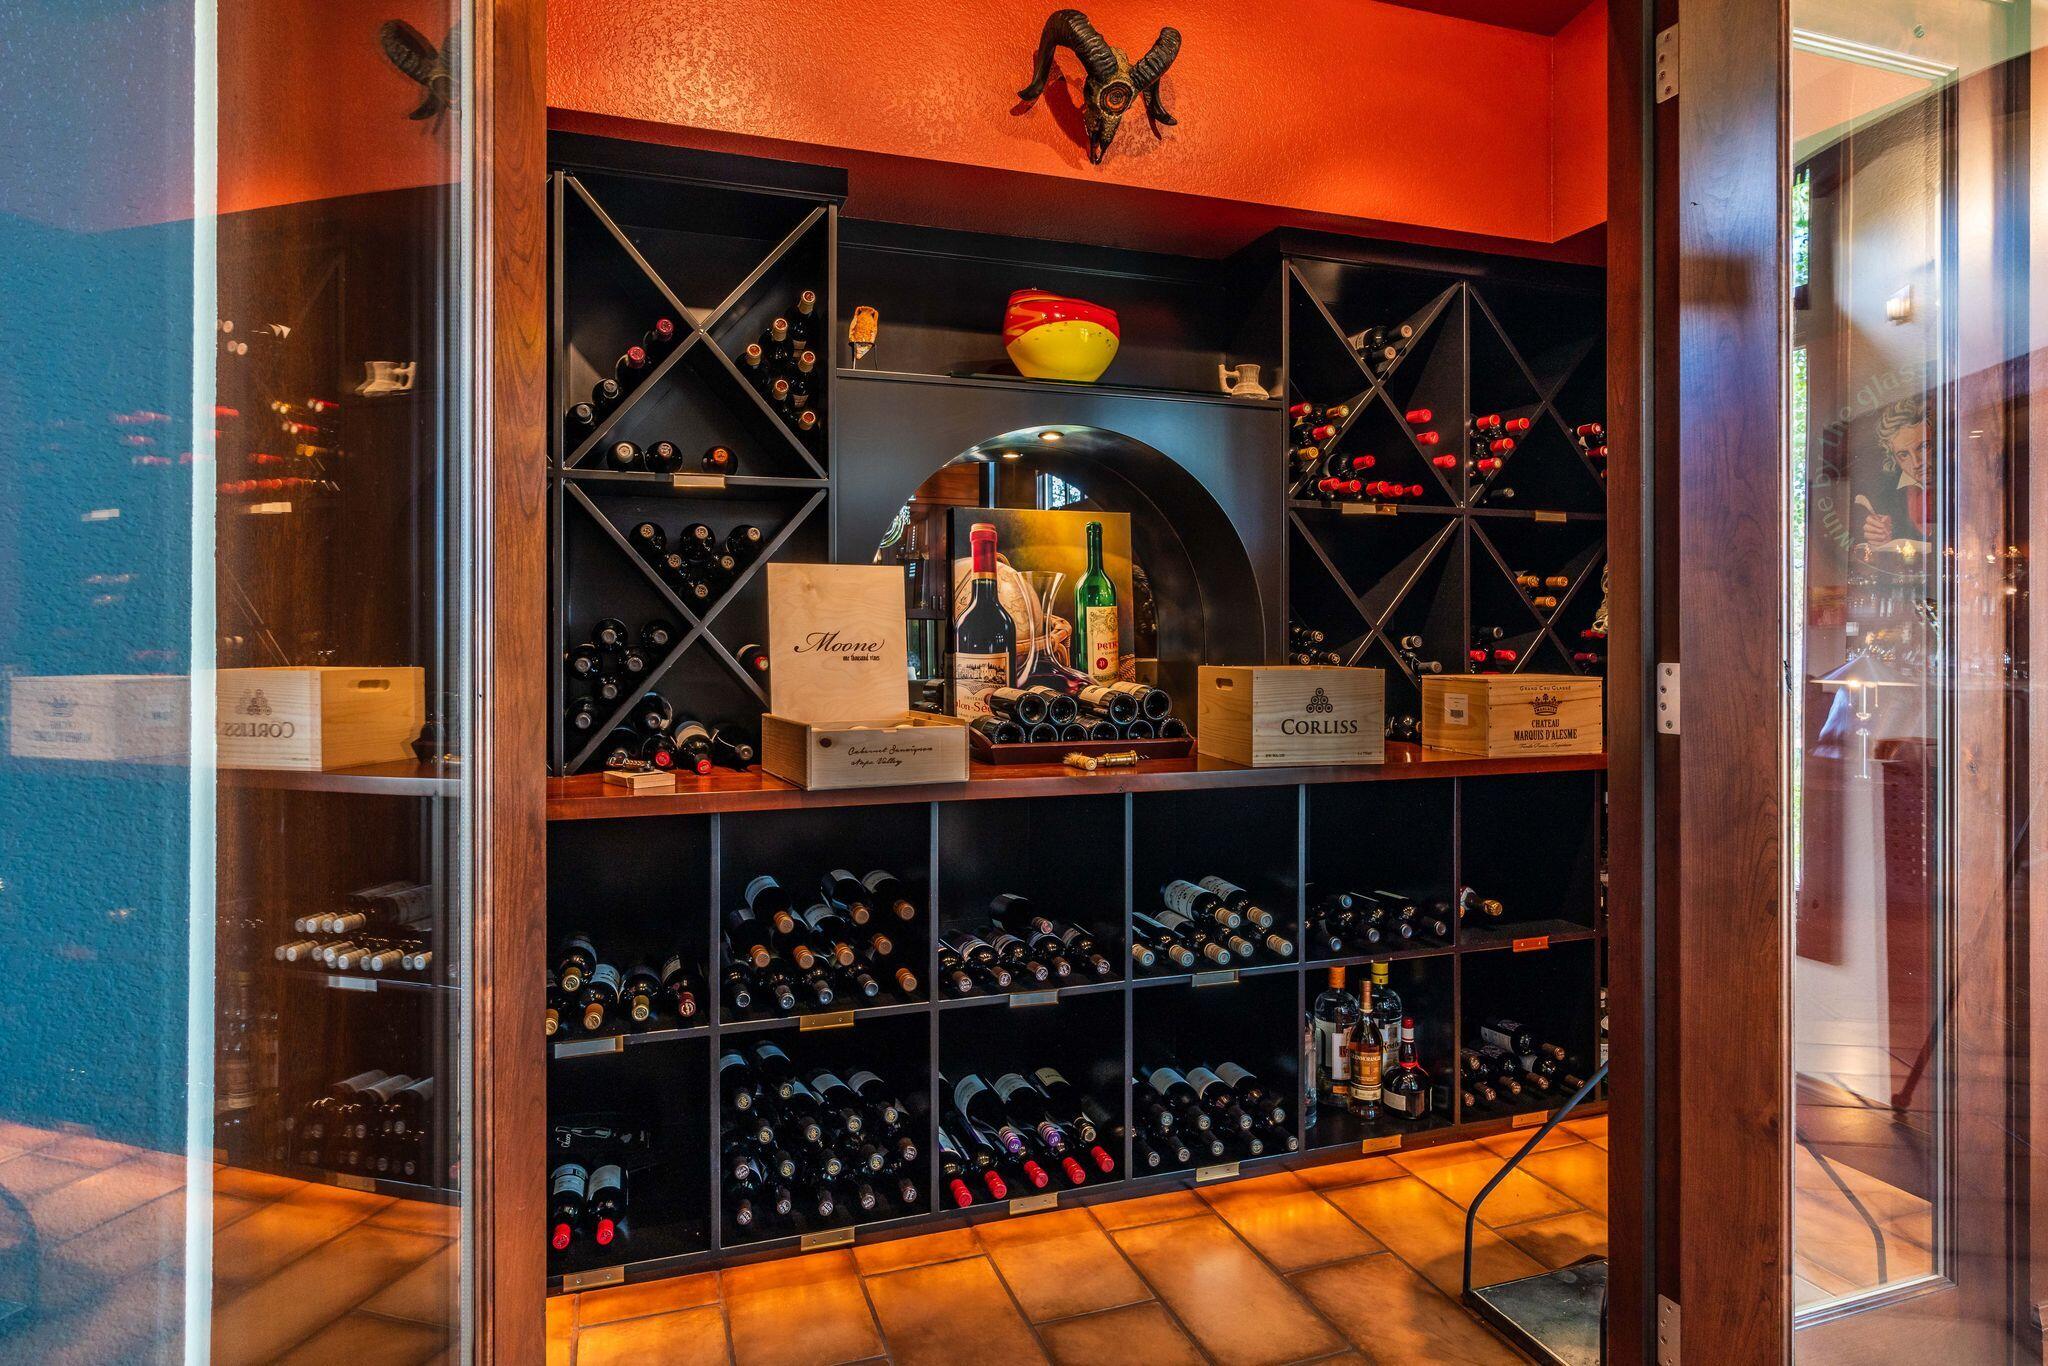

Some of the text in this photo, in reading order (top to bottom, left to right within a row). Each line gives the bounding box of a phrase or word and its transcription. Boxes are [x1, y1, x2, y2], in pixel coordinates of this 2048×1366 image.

[1817, 406, 1852, 448] the
[1812, 456, 1844, 489] by
[1818, 496, 1855, 551] Wine
[793, 630, 885, 653] Moone
[850, 652, 870, 661] thousand
[1281, 718, 1358, 735] CORLISS
[1531, 719, 1560, 728] CHATEAU
[1513, 727, 1578, 741] MARQUIS D'ALESME
[847, 746, 888, 756] Cabernet
[877, 757, 903, 767] Valley
